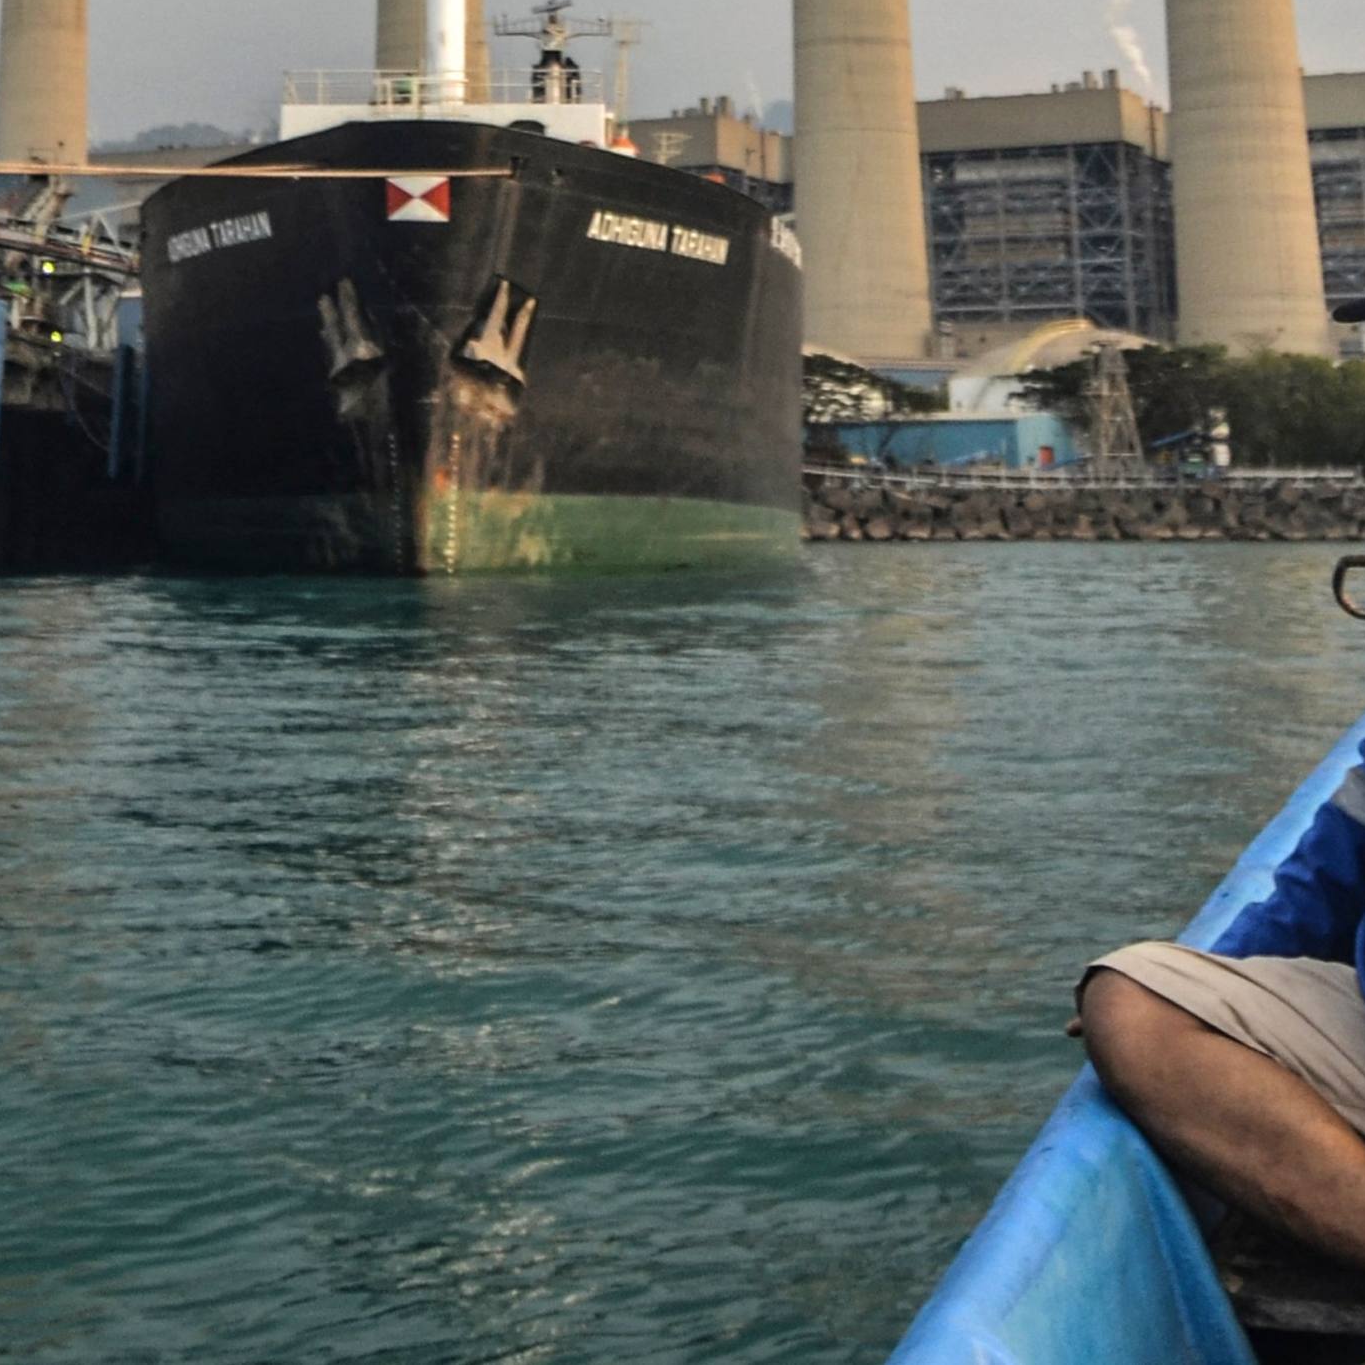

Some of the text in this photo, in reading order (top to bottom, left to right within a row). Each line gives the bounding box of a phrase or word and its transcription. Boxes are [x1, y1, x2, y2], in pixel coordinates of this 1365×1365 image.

[209, 211, 271, 248] TARAHAN
[586, 209, 668, 252] ADHIGUNA
[670, 225, 730, 266] TARAHAN
